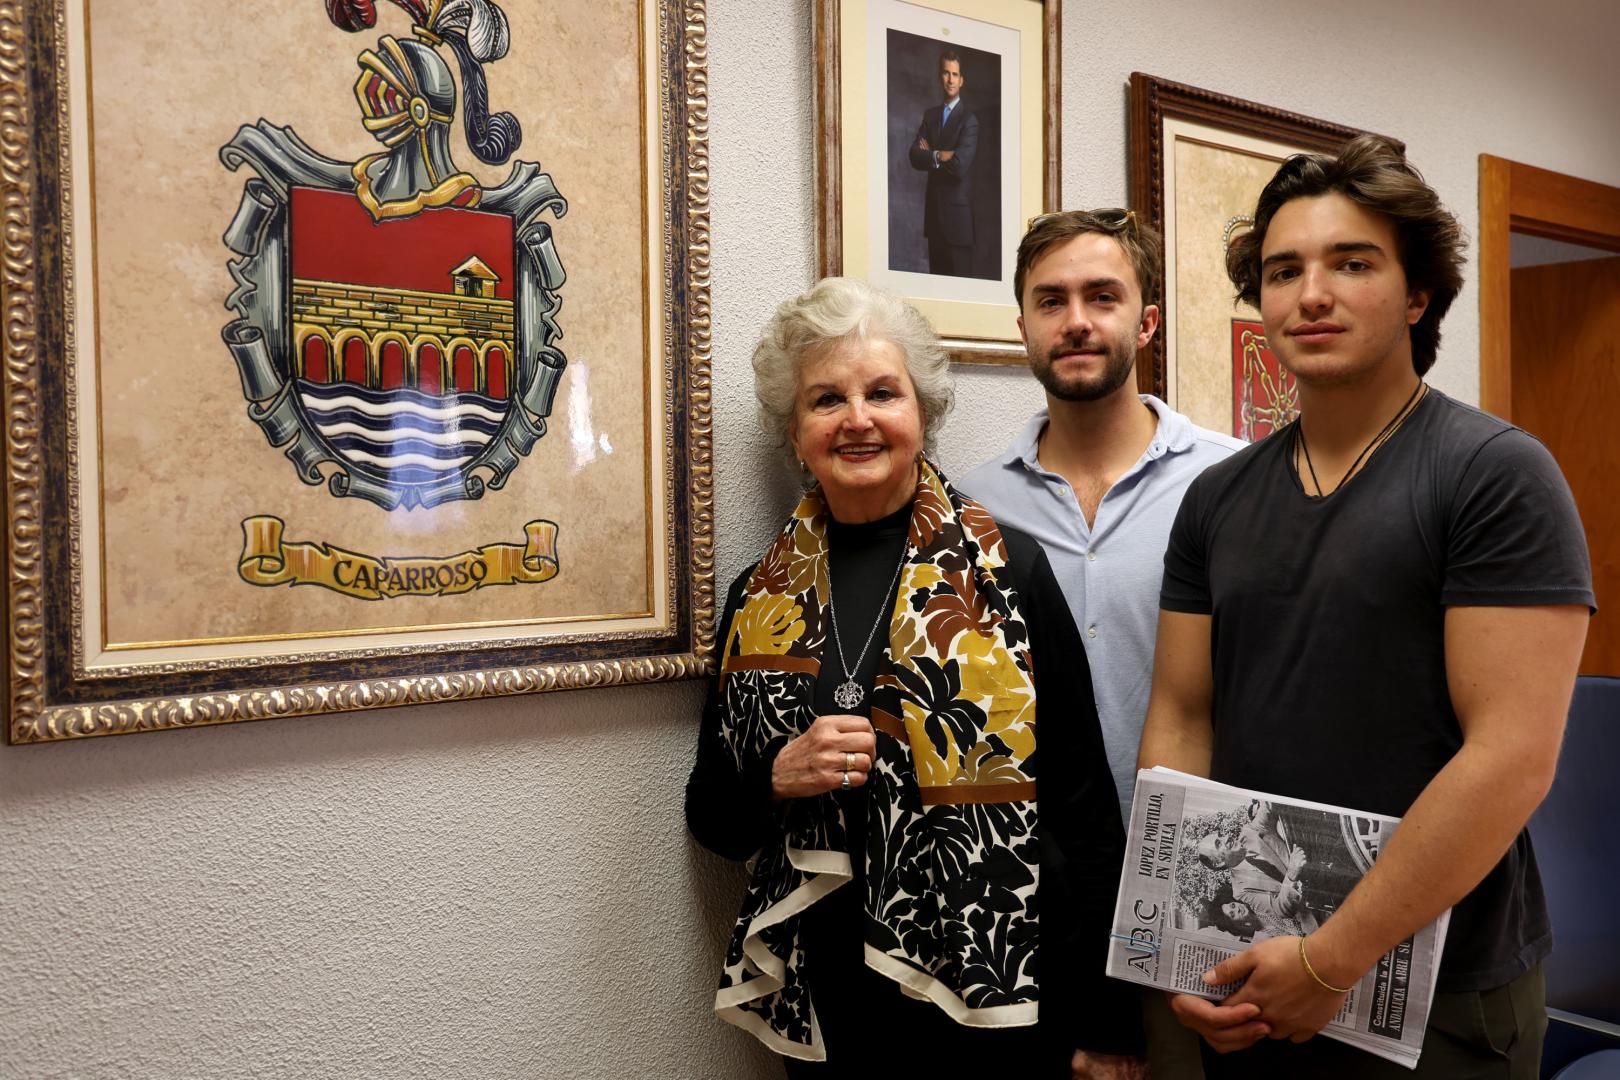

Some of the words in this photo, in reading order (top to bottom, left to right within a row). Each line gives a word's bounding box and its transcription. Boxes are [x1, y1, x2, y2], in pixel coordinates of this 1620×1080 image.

[333, 560, 487, 591] CAPARROSO
[1158, 823, 1177, 862] SEVILLA
[1138, 845, 1155, 877] LOPEZ
[1156, 866, 1169, 880] EN
[1127, 899, 1158, 977] ABC
[1379, 969, 1388, 978] la
[1395, 958, 1408, 982] ABRE
[1372, 981, 1387, 1027] Constituida
[1388, 988, 1405, 1032] ANDALUCIA
